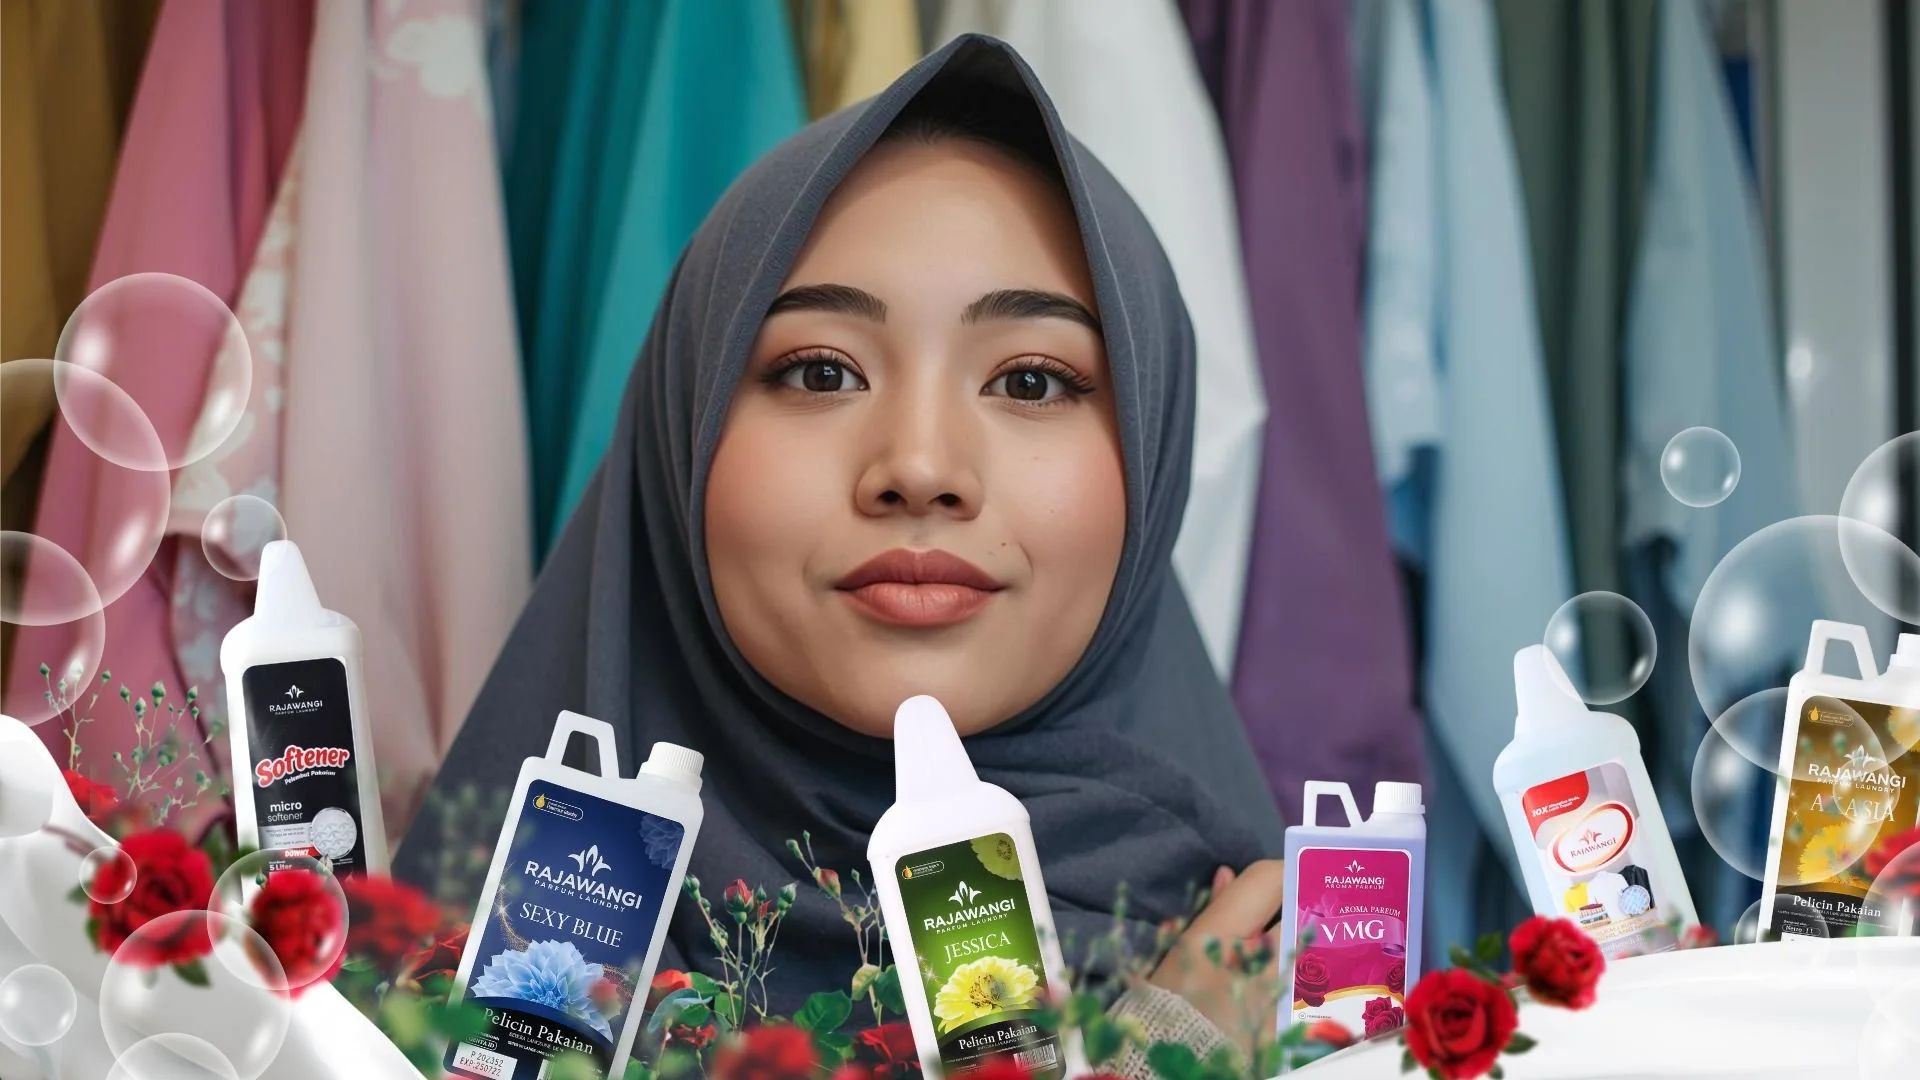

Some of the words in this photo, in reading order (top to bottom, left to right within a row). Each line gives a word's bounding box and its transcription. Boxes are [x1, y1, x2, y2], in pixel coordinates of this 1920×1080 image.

[269, 699, 323, 713] RAJAWANGI
[255, 744, 350, 788] Softener
[1808, 763, 1907, 789] RAJAWANGI
[1855, 783, 1895, 794] LAUNDRY
[267, 812, 303, 823] softener
[270, 800, 302, 813] micro
[1531, 805, 1549, 817] 10X
[1809, 793, 1896, 822] AASIA
[1570, 836, 1617, 858] RAJAWANGI
[524, 860, 643, 910] RAJAWANGI
[1324, 875, 1385, 885] RAJAWANGI
[534, 879, 575, 897] PARFUM
[579, 893, 625, 913] LAUNDRY
[1792, 895, 1833, 911] Pelicin
[1837, 901, 1881, 917] Pakaian
[923, 898, 1016, 931] RAJAWANGI
[1339, 905, 1368, 914] AROMA
[519, 902, 571, 930] SEXY
[572, 917, 623, 948] BLUE
[936, 923, 967, 935] PARFUM
[971, 913, 1008, 926] LAUNDRY
[944, 931, 1011, 964] JESSICA
[483, 1007, 533, 1036] Pelicin
[538, 1025, 594, 1055] Pakaian
[958, 1033, 995, 1050] Pelicin
[996, 1025, 1038, 1042] Pakaian
